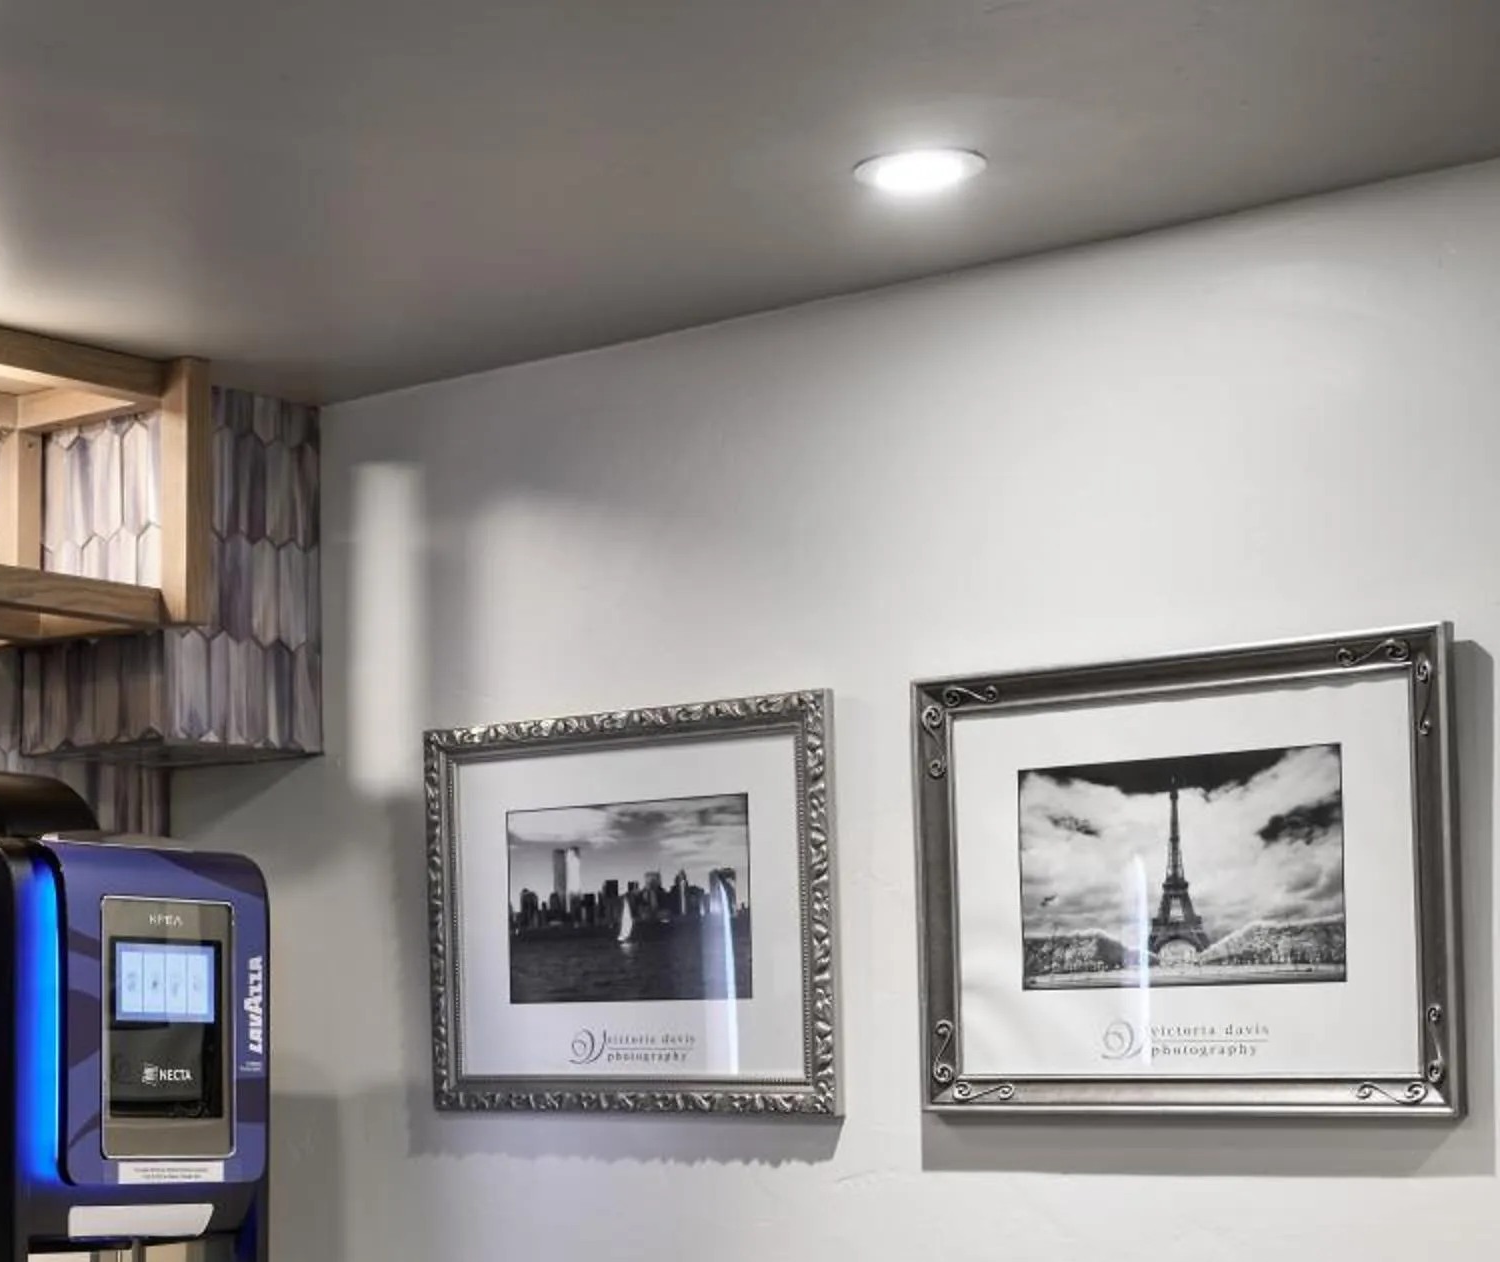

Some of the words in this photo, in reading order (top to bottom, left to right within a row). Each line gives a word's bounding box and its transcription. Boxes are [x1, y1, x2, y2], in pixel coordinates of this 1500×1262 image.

[243, 955, 263, 1055] LAVAZZA
[1151, 1022, 1216, 1036] victoria
[1224, 1022, 1270, 1036] davis
[607, 1051, 687, 1063] photography
[1151, 1043, 1257, 1058] photography
[159, 1068, 193, 1081] NECTA
